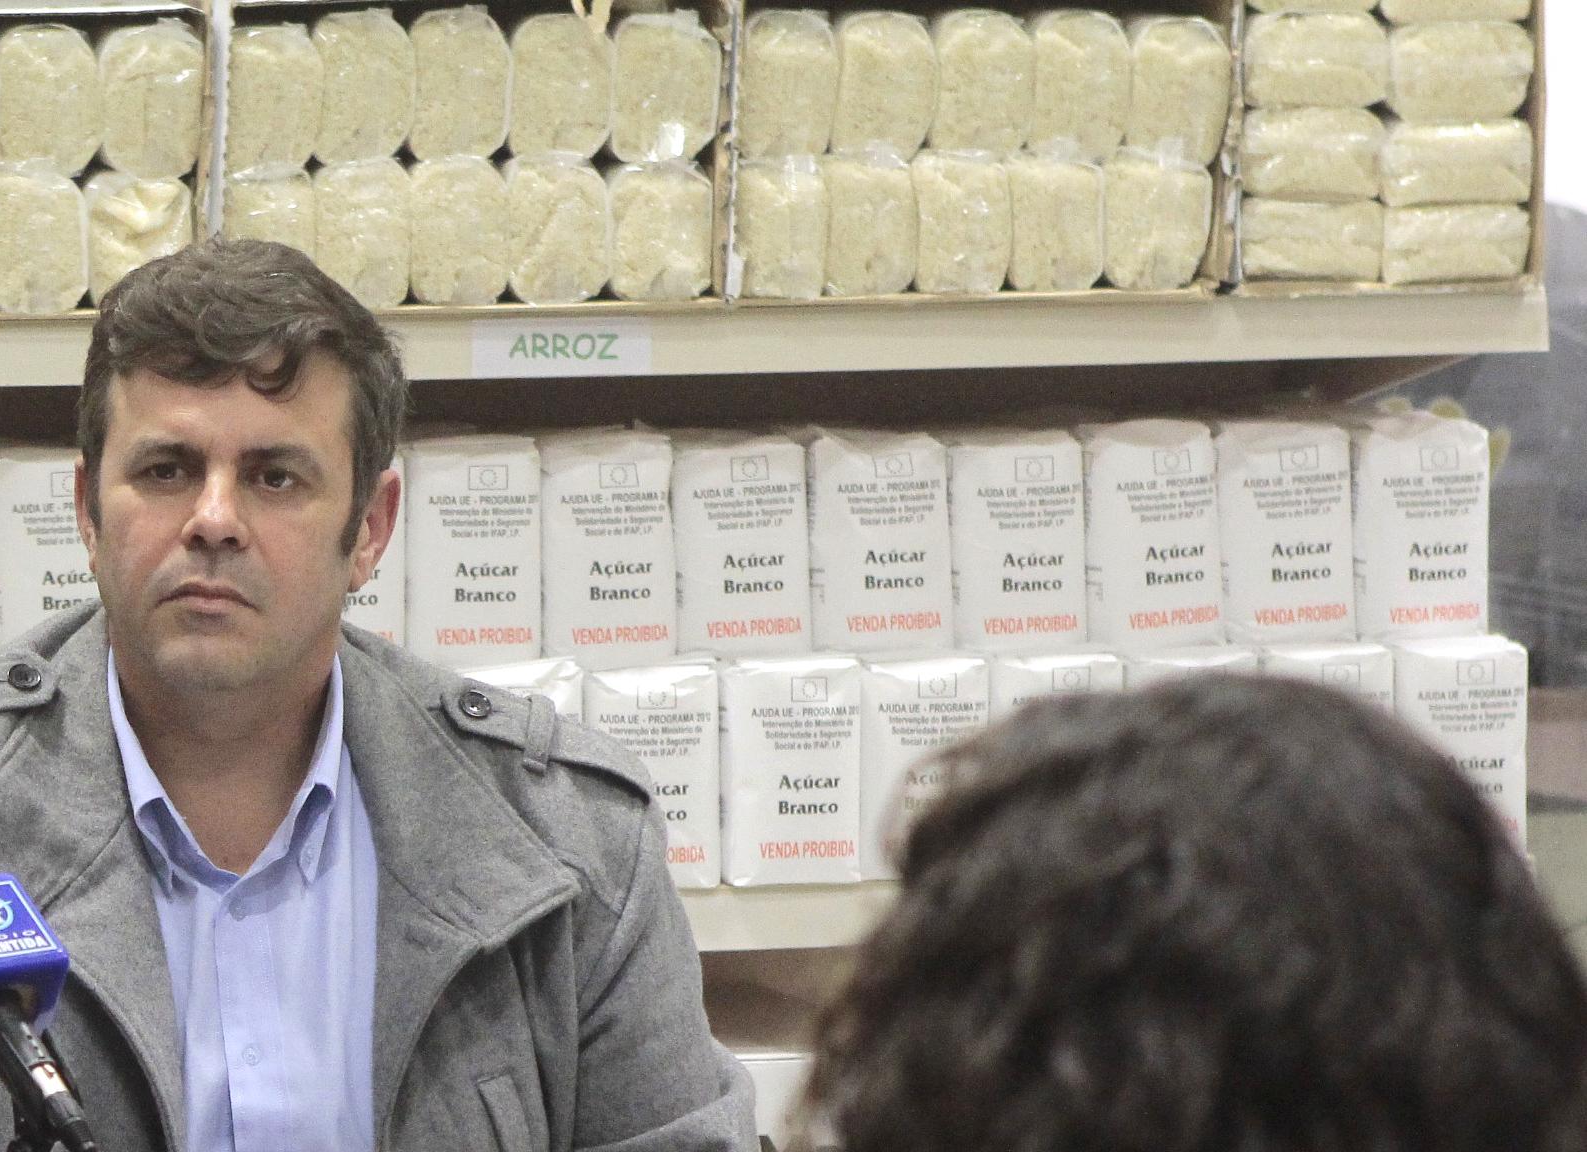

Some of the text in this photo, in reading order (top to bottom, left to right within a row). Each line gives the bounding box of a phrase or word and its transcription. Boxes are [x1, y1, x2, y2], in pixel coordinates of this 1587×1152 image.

[509, 333, 619, 359] ARROZ
[865, 549, 926, 567] Açúcar
[1146, 545, 1205, 563] Açúcar
[1271, 542, 1332, 558] Açúcar
[1409, 542, 1468, 559] Açúcar
[590, 560, 652, 578] Açúcar
[724, 553, 784, 571] Açúcar
[1003, 553, 1064, 570] Açúcar
[42, 570, 97, 587] Açúca
[456, 562, 518, 580] Açúcar
[1146, 570, 1204, 586] Branco
[1272, 567, 1331, 583] Branco
[1409, 567, 1467, 582] Branco
[724, 580, 783, 594] Branco
[865, 575, 924, 590] Branco
[1002, 578, 1062, 592] Branco
[455, 588, 516, 602] Branco
[590, 587, 651, 600] Branco
[846, 611, 941, 632] VENDA PROIBIDA
[1129, 605, 1219, 629] VENDA PROIBIDA
[1255, 604, 1347, 625] VENDA PROIBIDA
[707, 617, 802, 639] VENDA PROIBIDA
[984, 615, 1077, 634] VENDA PROIBIDA
[436, 627, 533, 645] VENDA PROIBIDA
[572, 624, 669, 645] VENDA PROIBIDA
[752, 706, 847, 718] AJUDA UE PROGRAMA
[878, 703, 974, 714] AJUDA UE PROGRAMA
[600, 713, 693, 724] AJUDA UE PROGRAMA
[779, 774, 840, 792] Açúcar
[779, 801, 838, 815] Branco
[667, 847, 705, 863] OIBIDA
[760, 840, 855, 859] VENDA PROIBIDA
